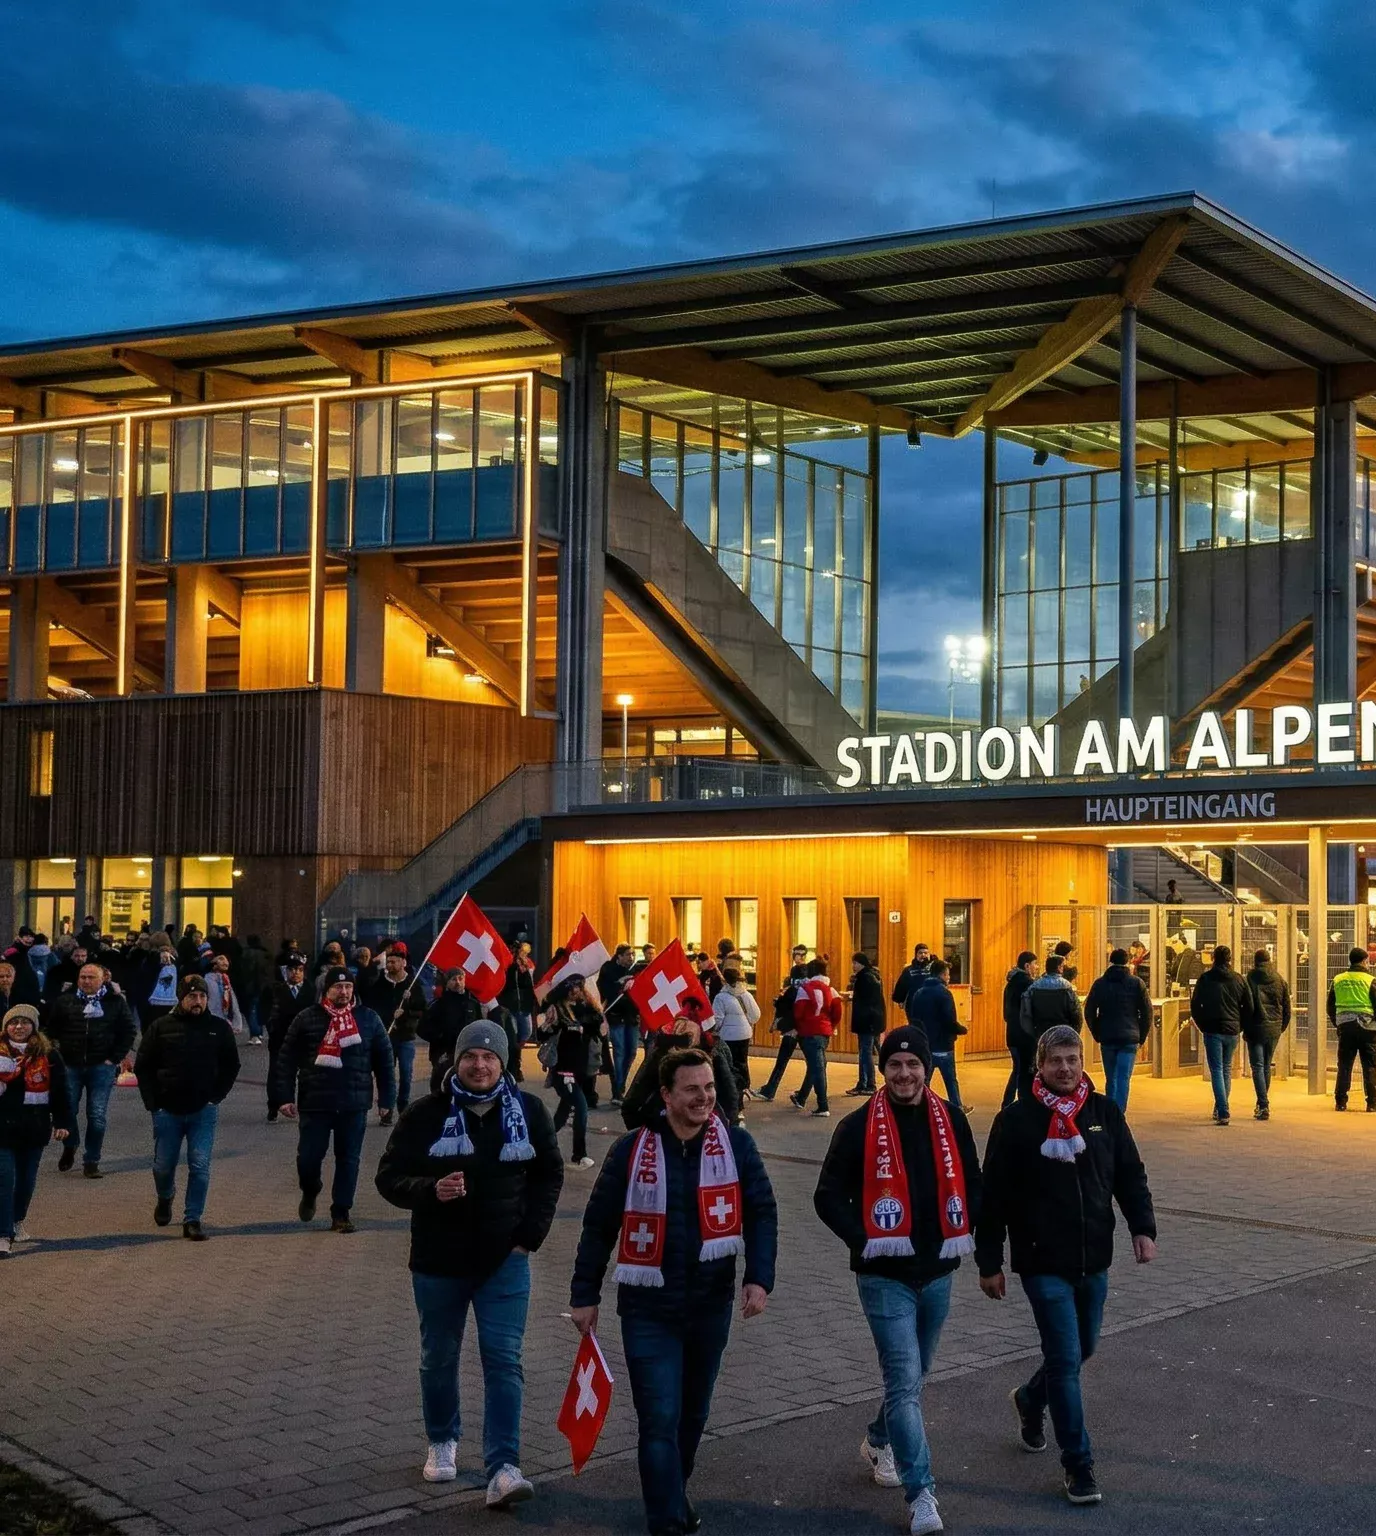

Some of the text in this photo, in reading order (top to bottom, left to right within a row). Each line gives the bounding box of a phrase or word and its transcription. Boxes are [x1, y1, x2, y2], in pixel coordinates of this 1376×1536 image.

[836, 724, 1056, 788] STADION
[1073, 715, 1166, 776] AM
[1085, 792, 1276, 823] HAUPTEINGANG
